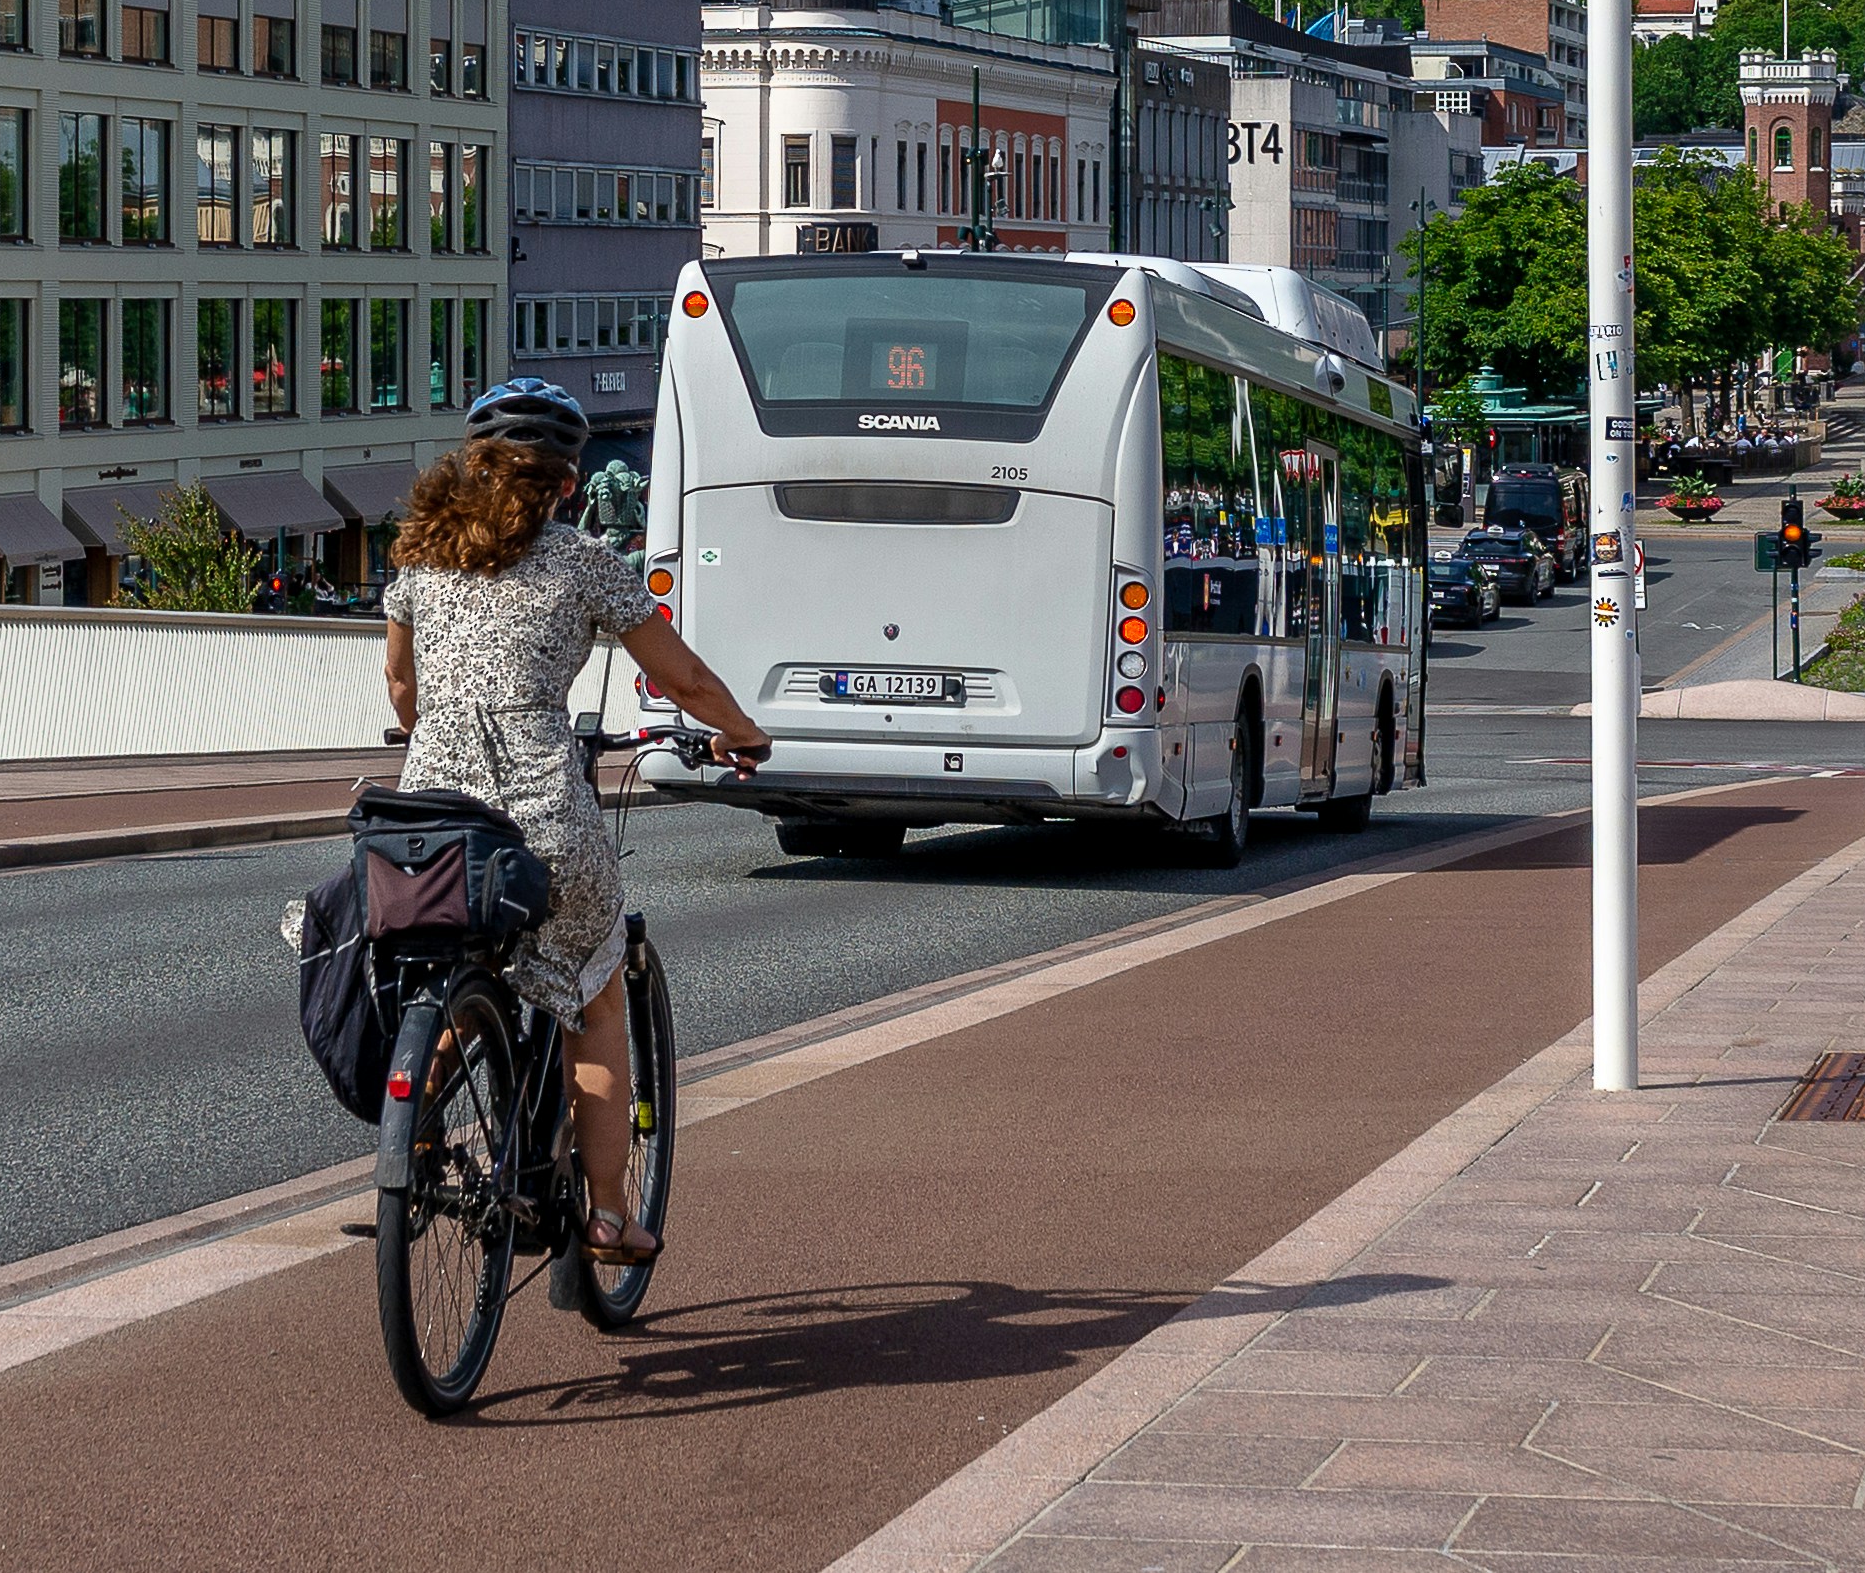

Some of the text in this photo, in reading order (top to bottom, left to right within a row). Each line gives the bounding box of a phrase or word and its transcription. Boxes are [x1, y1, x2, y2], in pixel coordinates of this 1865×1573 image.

[887, 346, 925, 388] 96
[858, 414, 941, 431] SCANIA
[991, 466, 1028, 480] 2105
[853, 675, 936, 694] GA 12139
